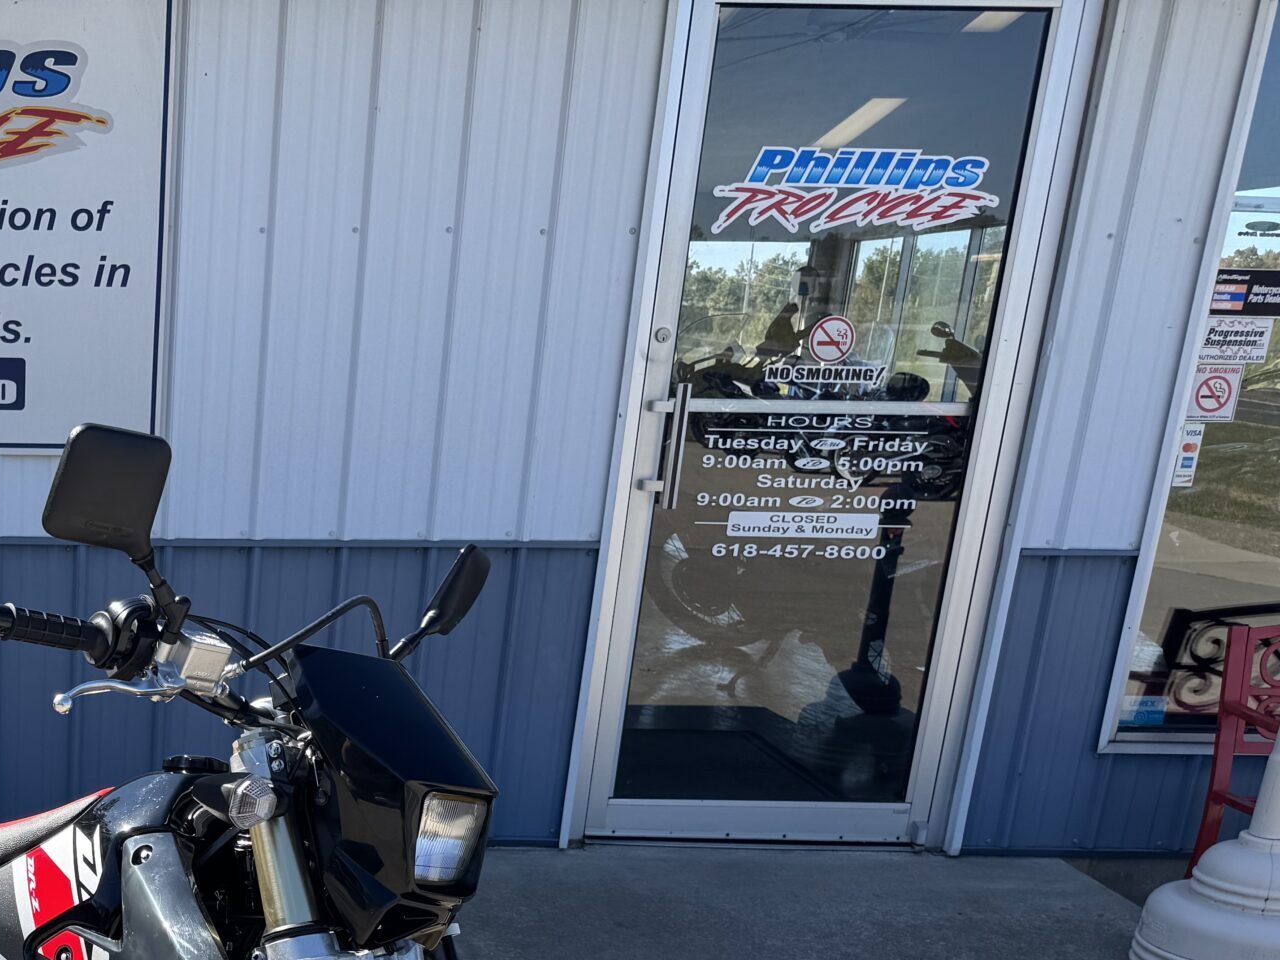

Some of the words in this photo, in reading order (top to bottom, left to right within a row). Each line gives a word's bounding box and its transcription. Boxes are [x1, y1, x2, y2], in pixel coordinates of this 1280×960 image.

[749, 148, 985, 188] Phillips
[70, 200, 113, 231] of
[716, 187, 828, 229] PRO
[813, 188, 996, 227] CYCLE
[94, 256, 131, 287] in
[1248, 294, 1264, 303] Parts
[1204, 337, 1257, 348] Suspension
[1208, 328, 1265, 339] Progressive
[766, 366, 792, 382] NO
[794, 365, 885, 386] SMOKING!
[767, 415, 872, 429] HOURS
[705, 435, 804, 453] Tuesday
[853, 436, 928, 455] Friday
[702, 454, 787, 469] 9:00am
[838, 456, 924, 475] 5:00pm
[756, 474, 863, 493] Saturday
[696, 493, 781, 508] 9:00am
[830, 494, 916, 511] 2:00pm
[769, 513, 838, 525] CLOSED
[730, 524, 791, 535] Sunday
[795, 524, 808, 534] &
[810, 525, 873, 537] Monday
[711, 543, 887, 560] 618-457-8600
[28, 855, 41, 914] DR-Z
